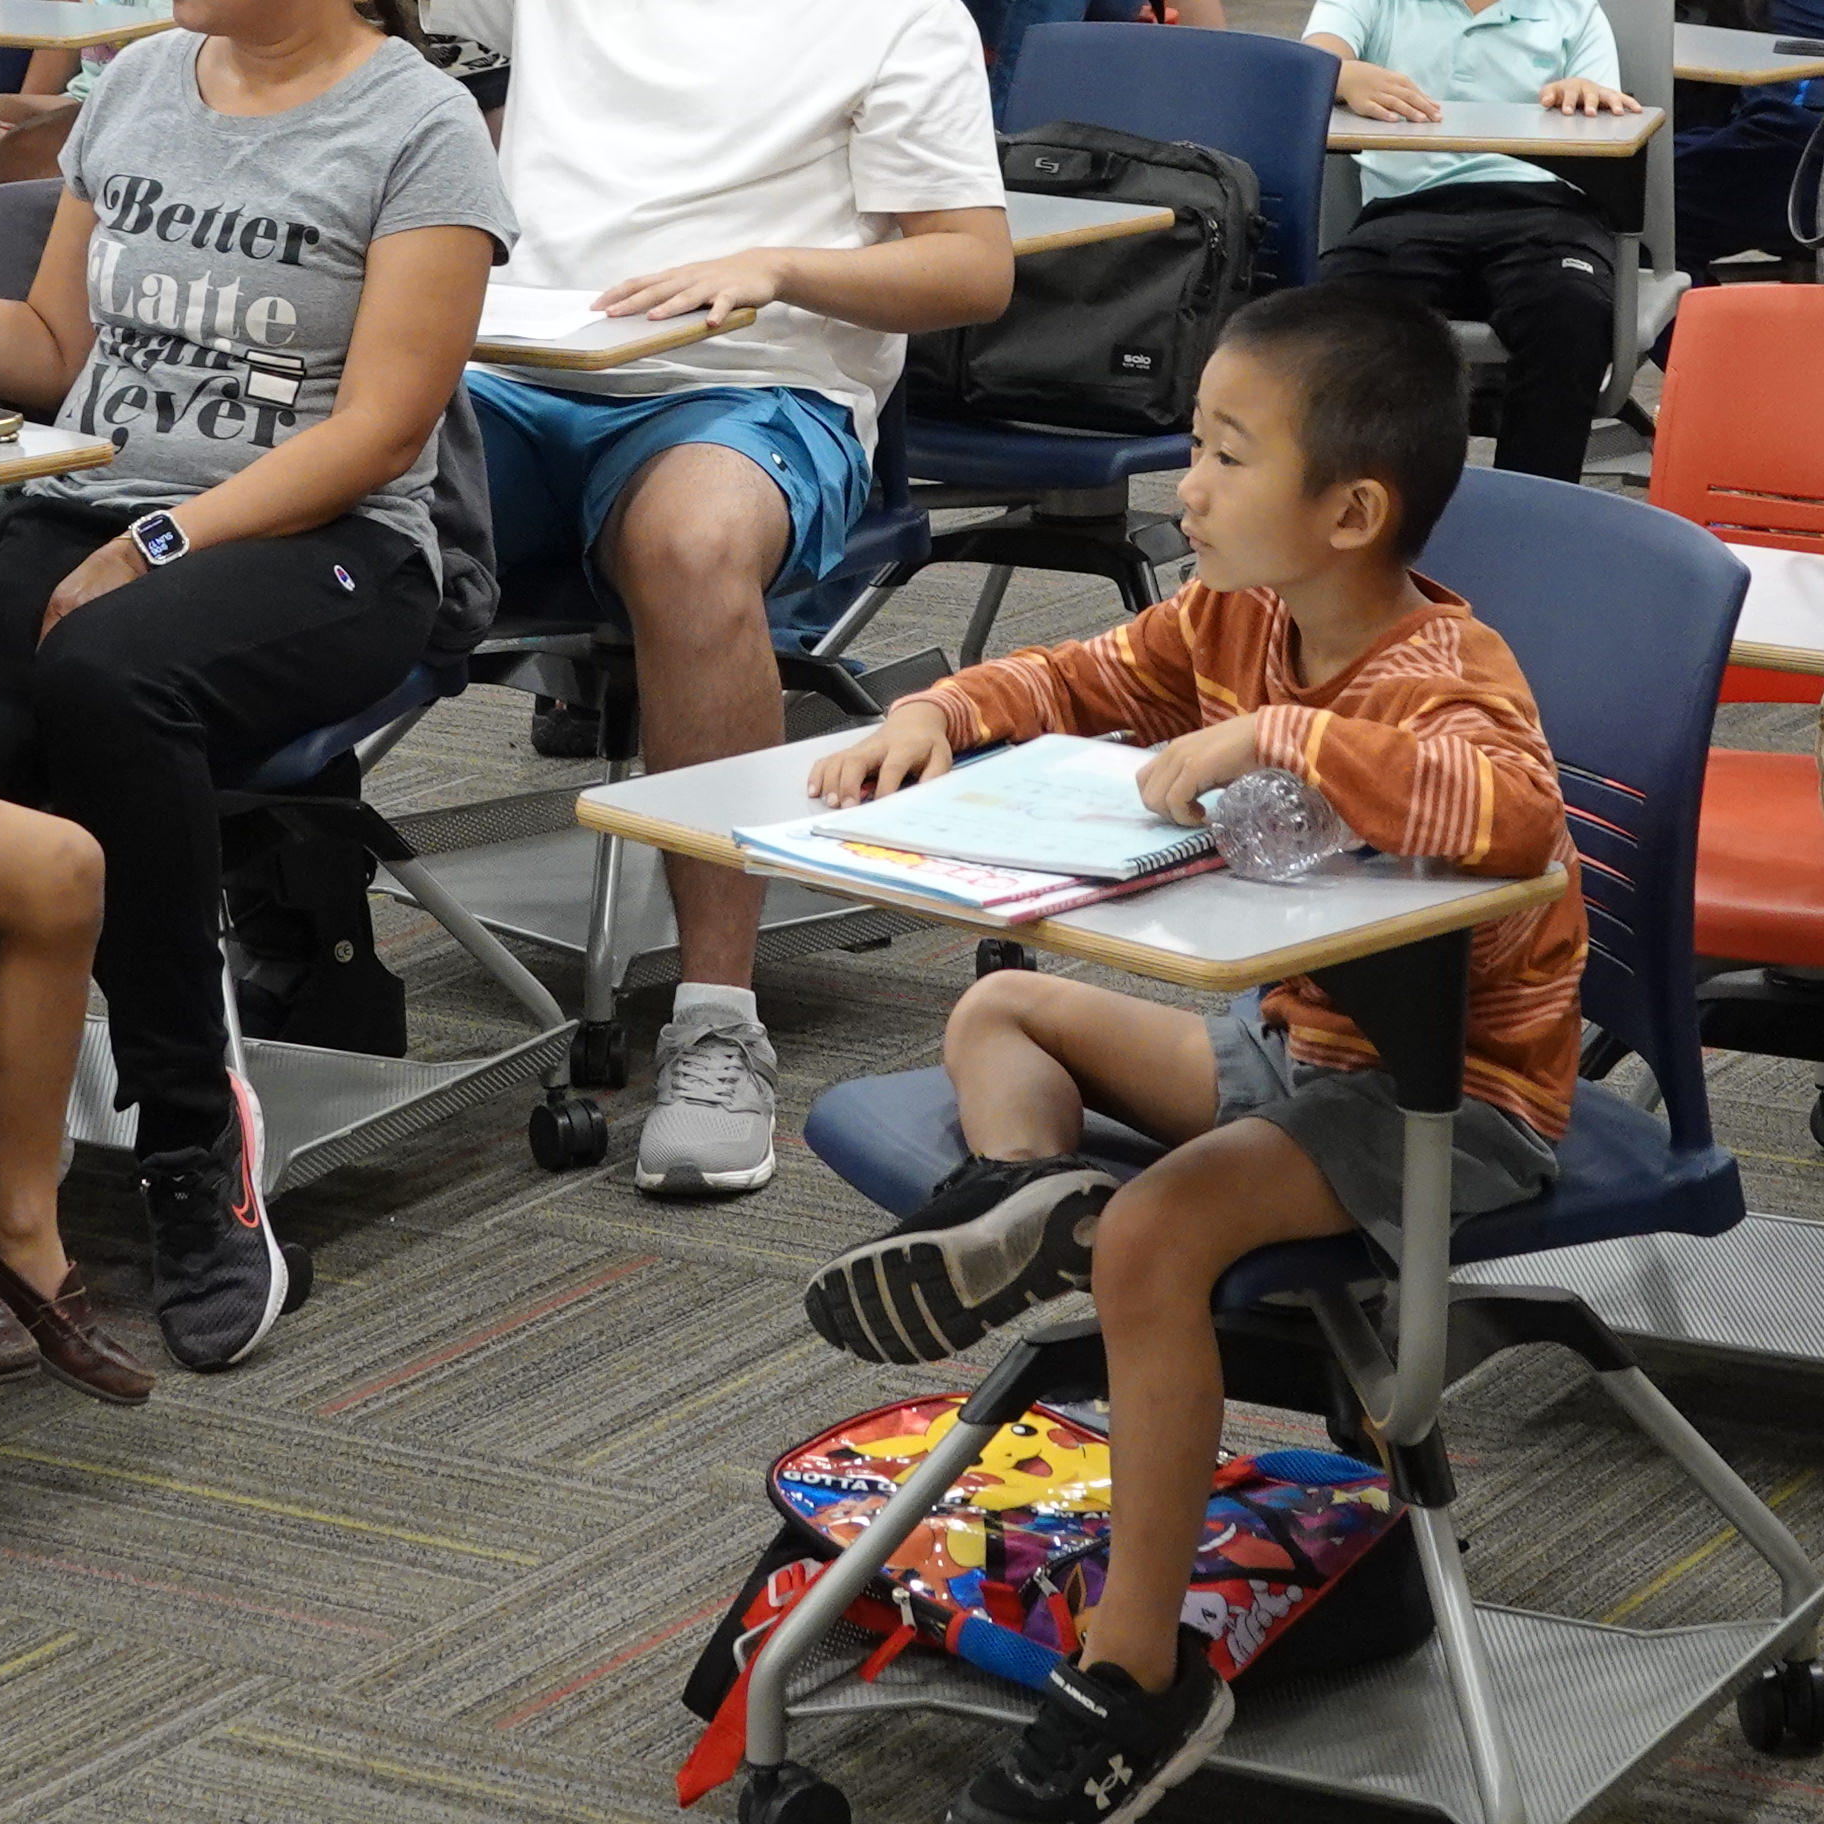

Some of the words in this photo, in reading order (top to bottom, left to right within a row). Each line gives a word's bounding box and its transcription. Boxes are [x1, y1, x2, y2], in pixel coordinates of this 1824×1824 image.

[103, 174, 320, 266] Better
[87, 238, 297, 350] Latte
[782, 1469, 871, 1493] GOTTA
